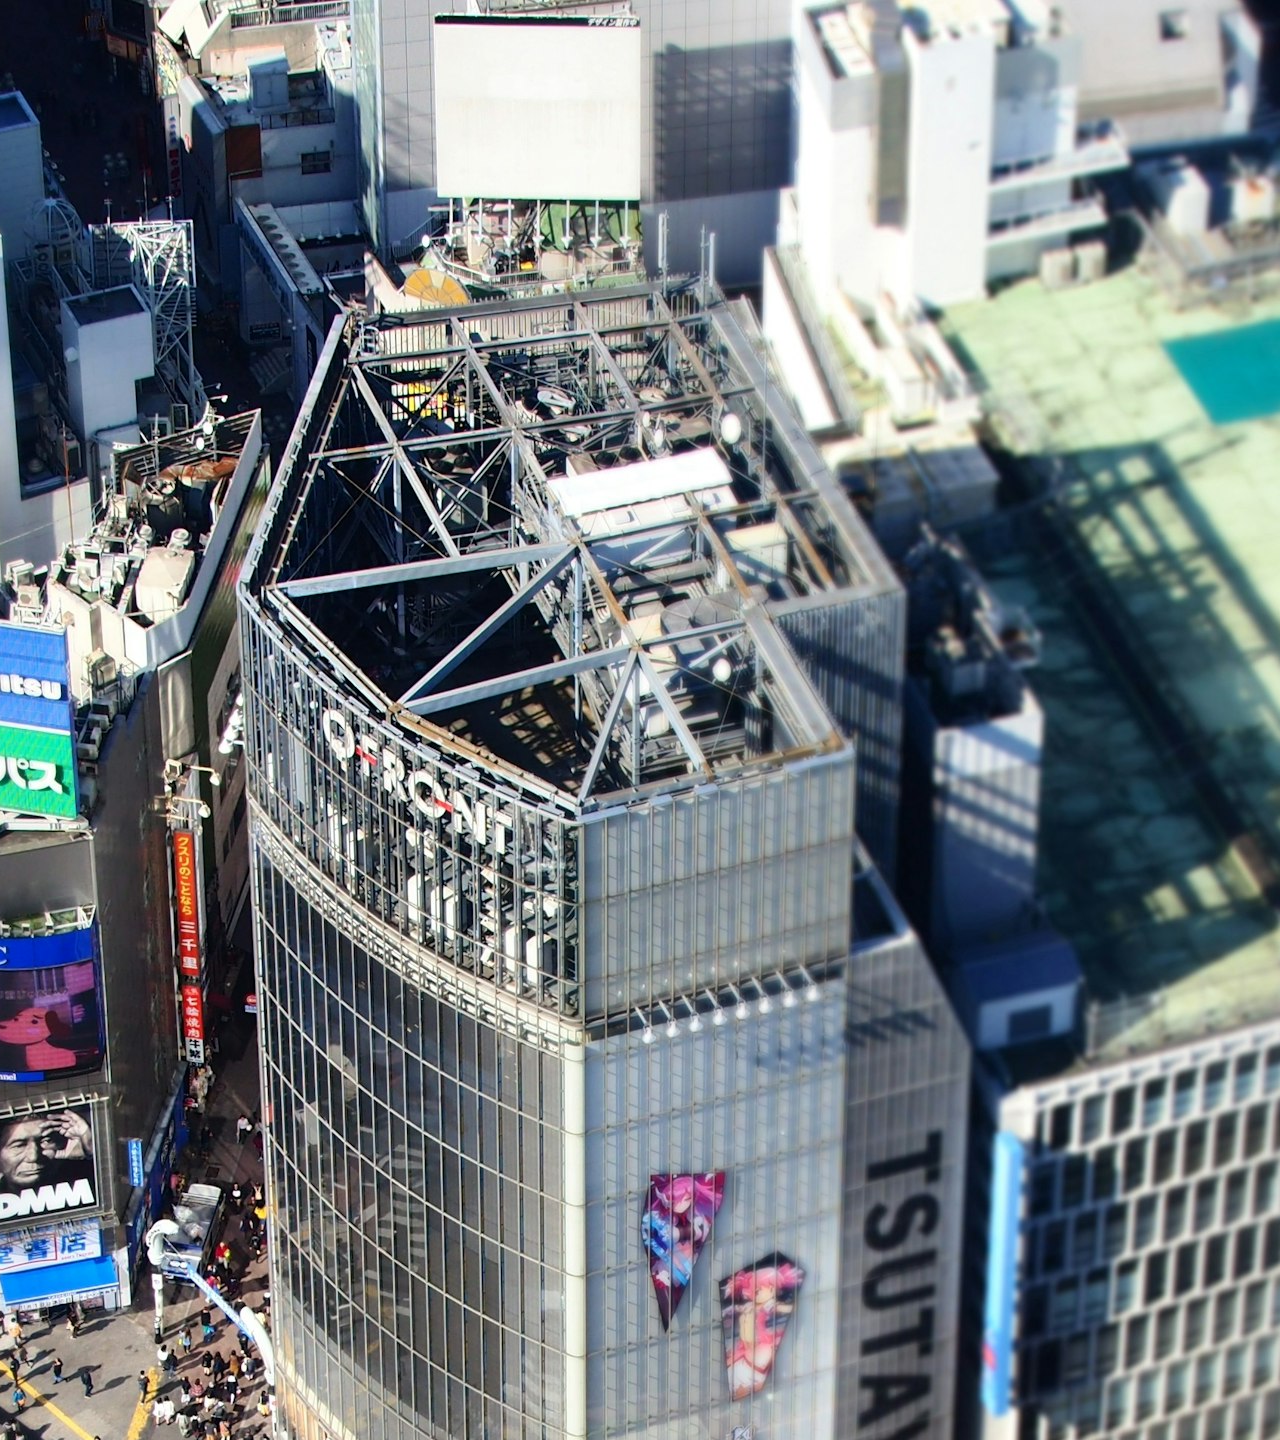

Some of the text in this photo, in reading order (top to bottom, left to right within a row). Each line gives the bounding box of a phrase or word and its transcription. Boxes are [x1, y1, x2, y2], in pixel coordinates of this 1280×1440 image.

[177, 836, 199, 970] クスリのことなら 三千里
